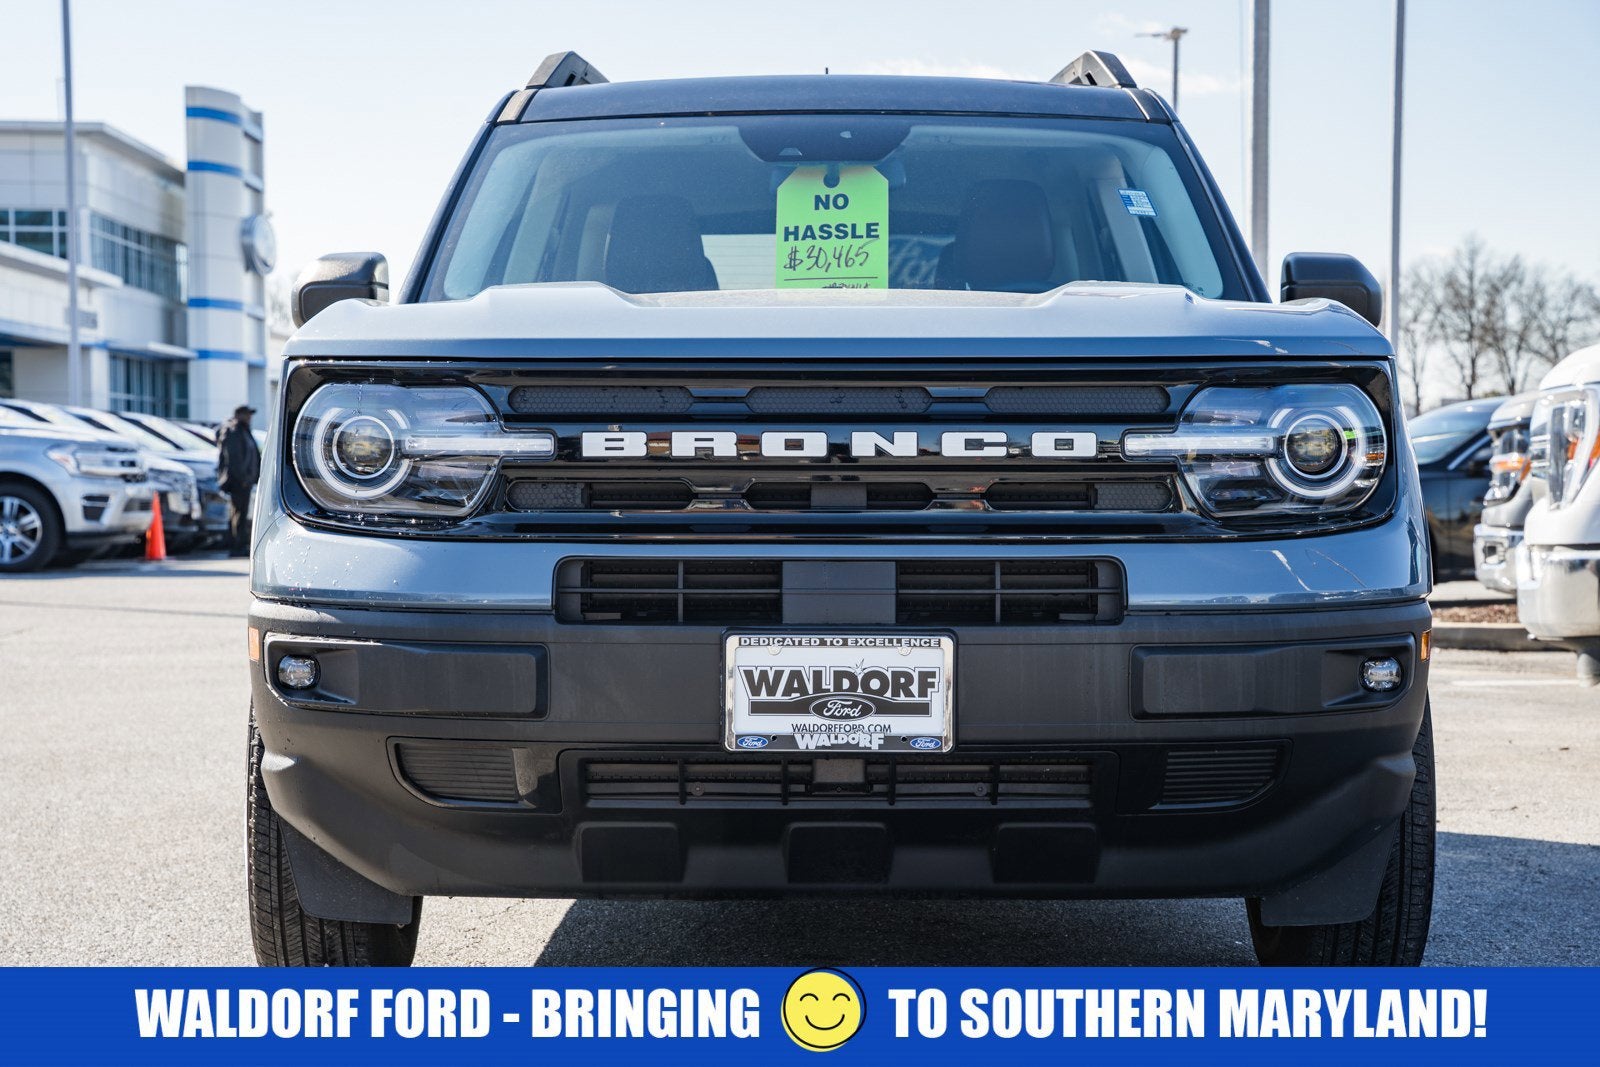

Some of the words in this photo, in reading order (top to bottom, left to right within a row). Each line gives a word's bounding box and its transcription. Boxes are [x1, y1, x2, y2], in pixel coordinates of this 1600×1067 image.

[814, 193, 850, 211] NO
[783, 222, 880, 242] HASSLE
[783, 238, 880, 273] $30,465
[581, 430, 1098, 458] BRONCO
[740, 637, 820, 646] DEDICATED
[823, 638, 843, 646] TO
[847, 638, 940, 647] EXCELLENCE
[739, 667, 939, 699] WALDORF
[822, 700, 862, 718] Ford
[742, 738, 763, 747] Ford
[793, 732, 885, 750] WALDORF
[915, 739, 936, 748] Ford
